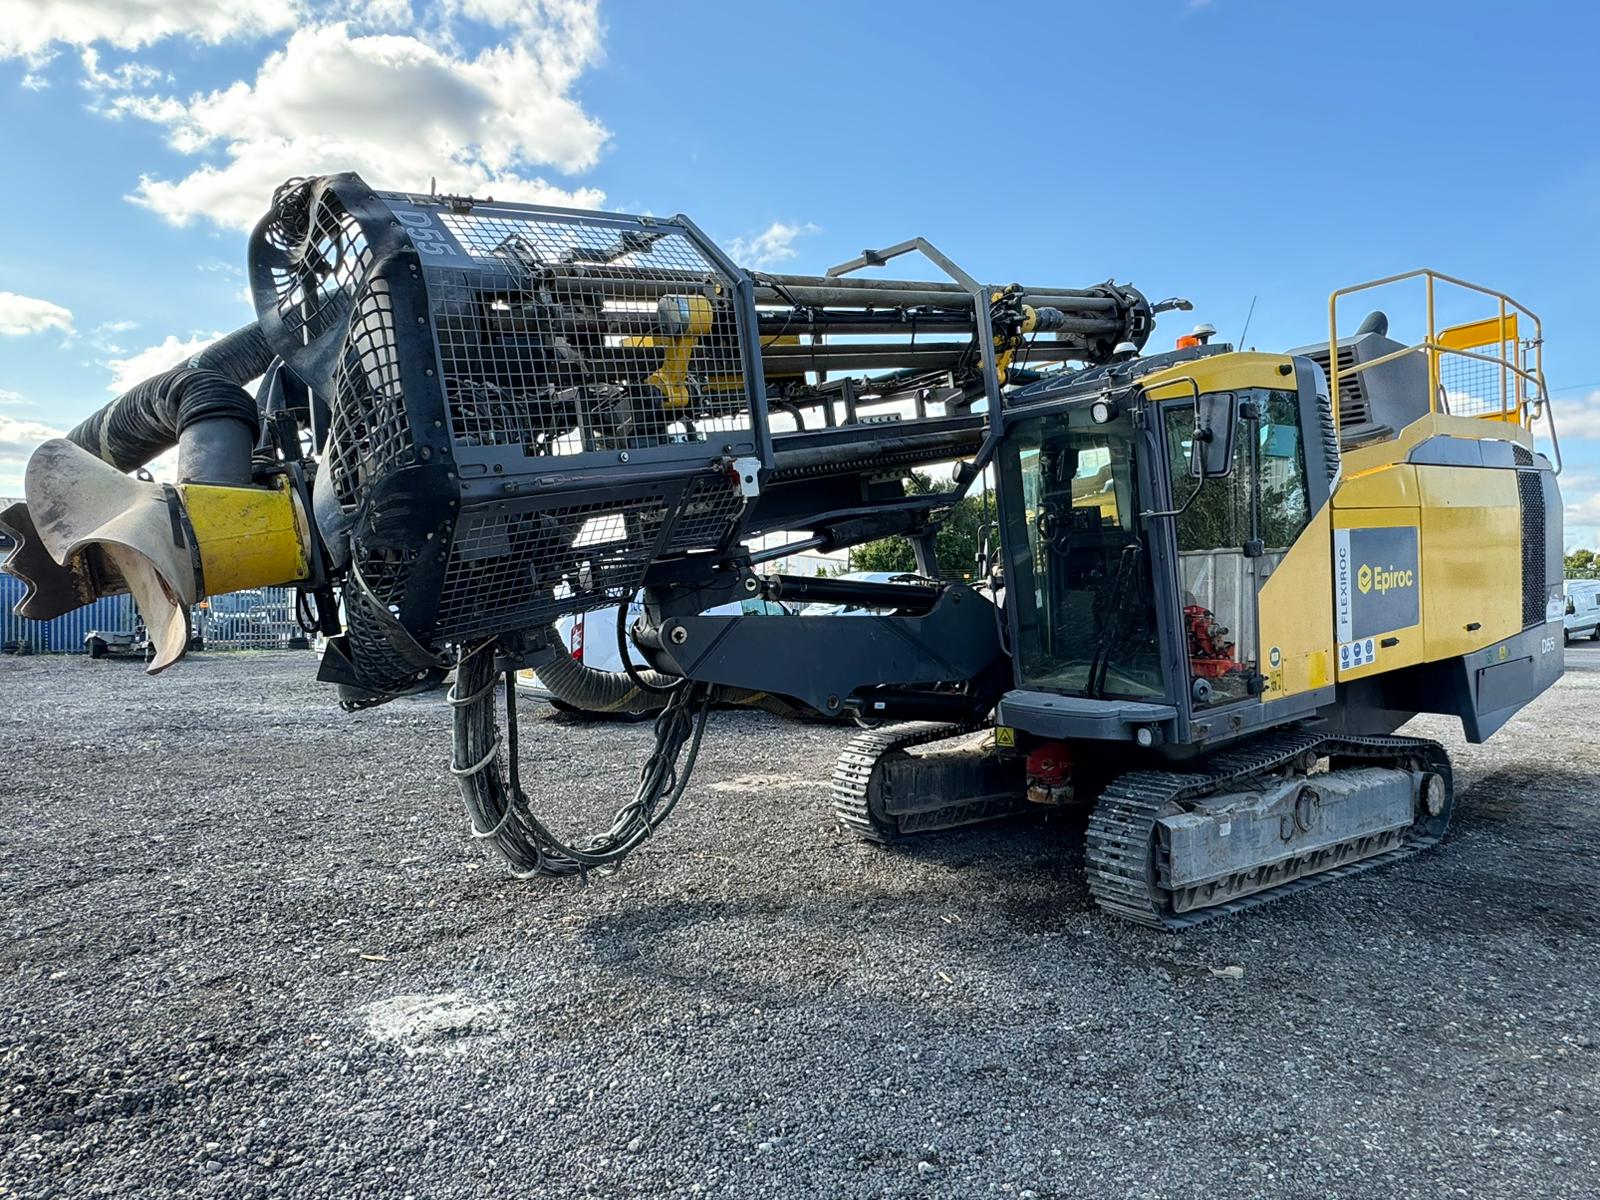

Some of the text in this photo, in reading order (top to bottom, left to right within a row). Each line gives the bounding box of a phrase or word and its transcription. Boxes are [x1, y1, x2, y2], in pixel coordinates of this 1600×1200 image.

[391, 210, 457, 256] D55
[1339, 547, 1348, 624] FLEXIROC
[1374, 564, 1413, 595] Epiroc
[1541, 636, 1556, 654] D55
